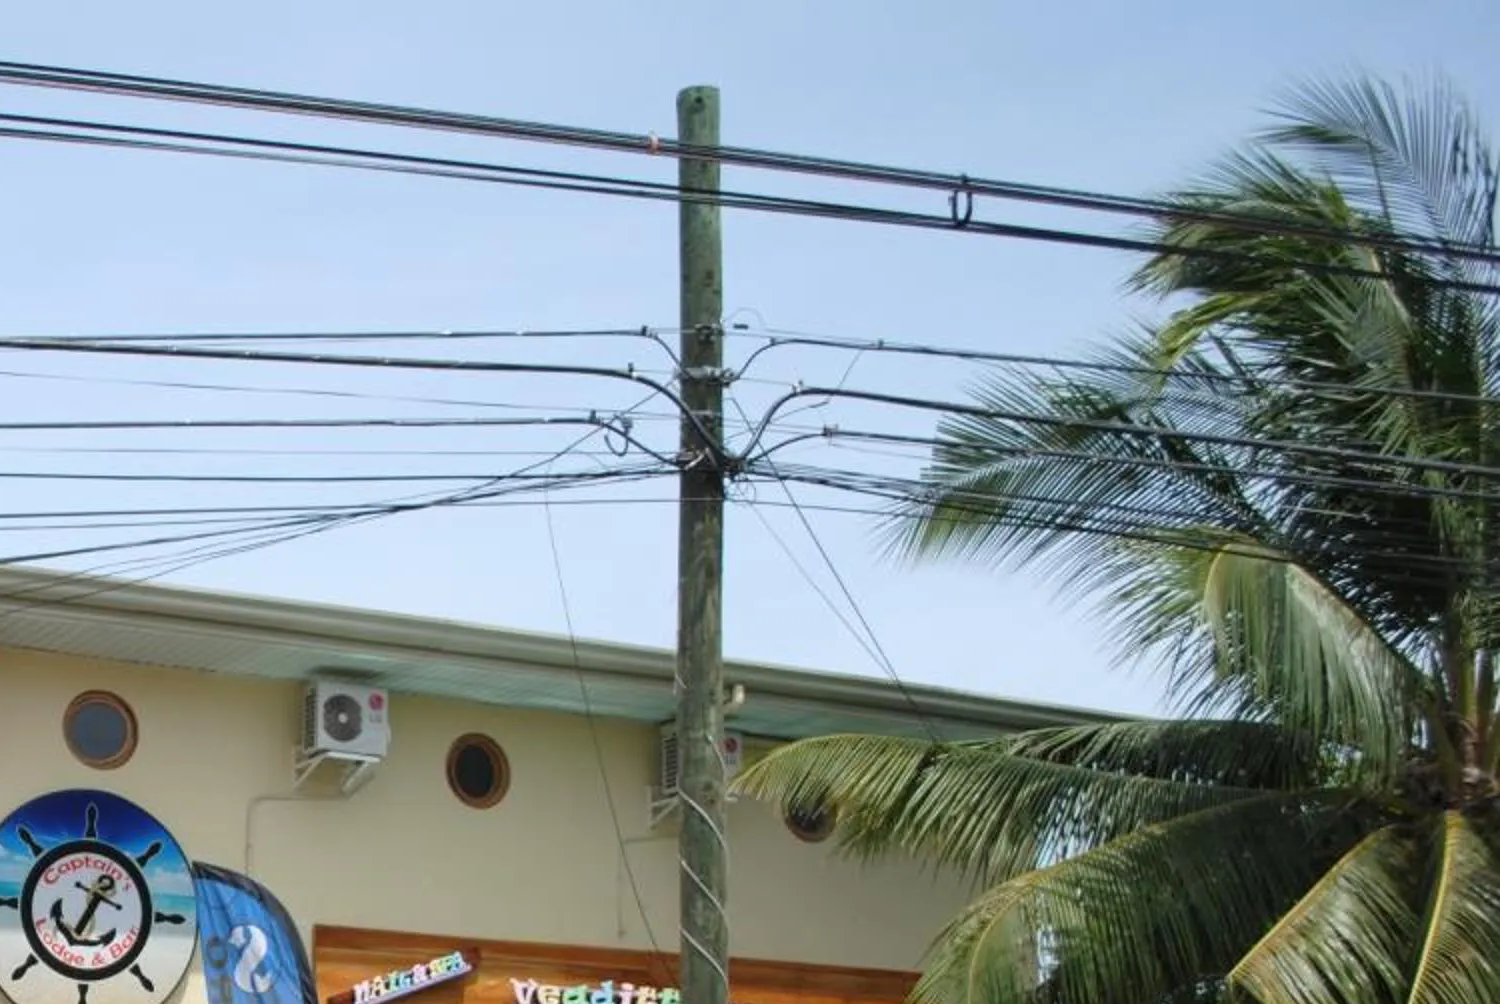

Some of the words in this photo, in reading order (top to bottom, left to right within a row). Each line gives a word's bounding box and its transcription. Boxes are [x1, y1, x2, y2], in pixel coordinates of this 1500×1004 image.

[44, 856, 133, 891] Captain's
[36, 917, 85, 965] Lodge
[91, 951, 105, 966] &
[109, 927, 138, 959] Bar
